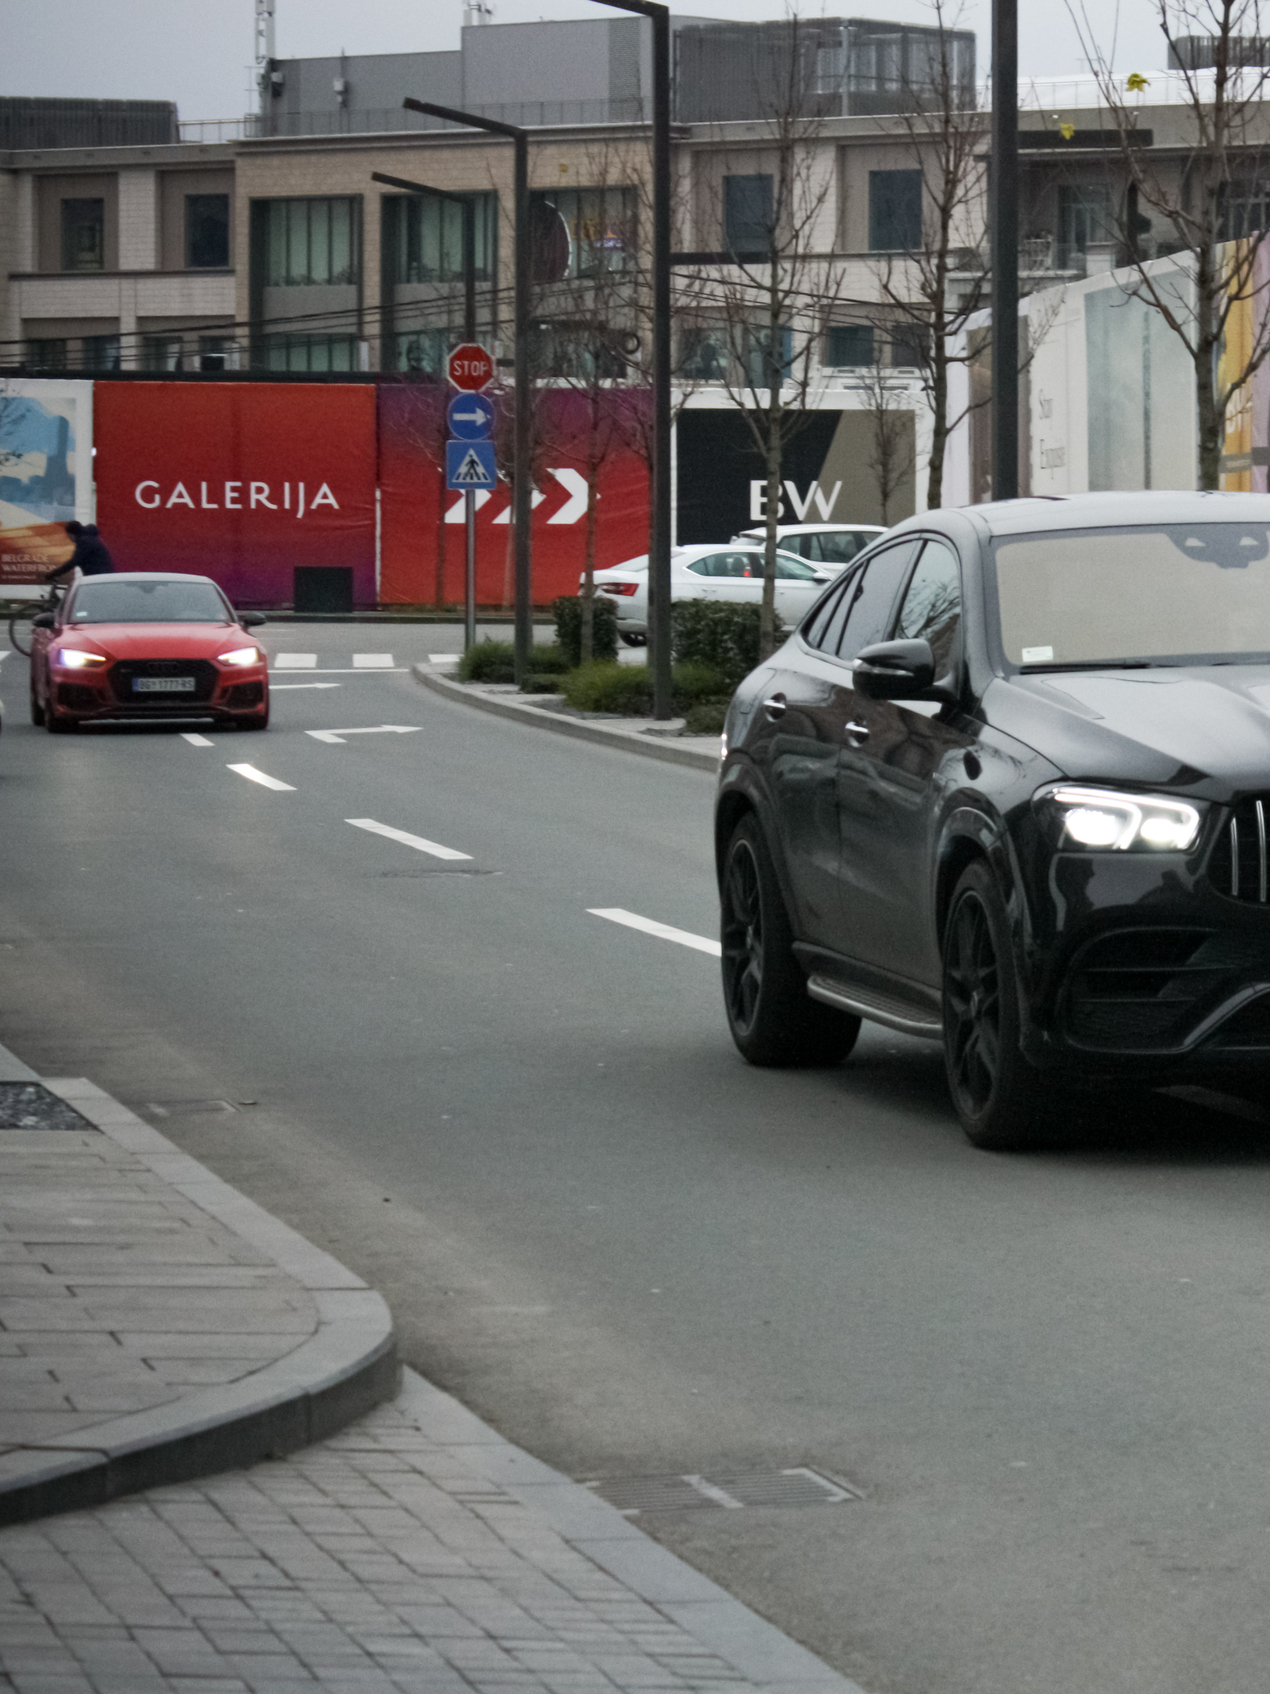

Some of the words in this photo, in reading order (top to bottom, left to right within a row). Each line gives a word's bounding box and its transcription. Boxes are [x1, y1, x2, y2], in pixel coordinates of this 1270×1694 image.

[453, 360, 489, 376] STOP
[135, 480, 340, 518] GALERIJA
[750, 480, 842, 521] BW
